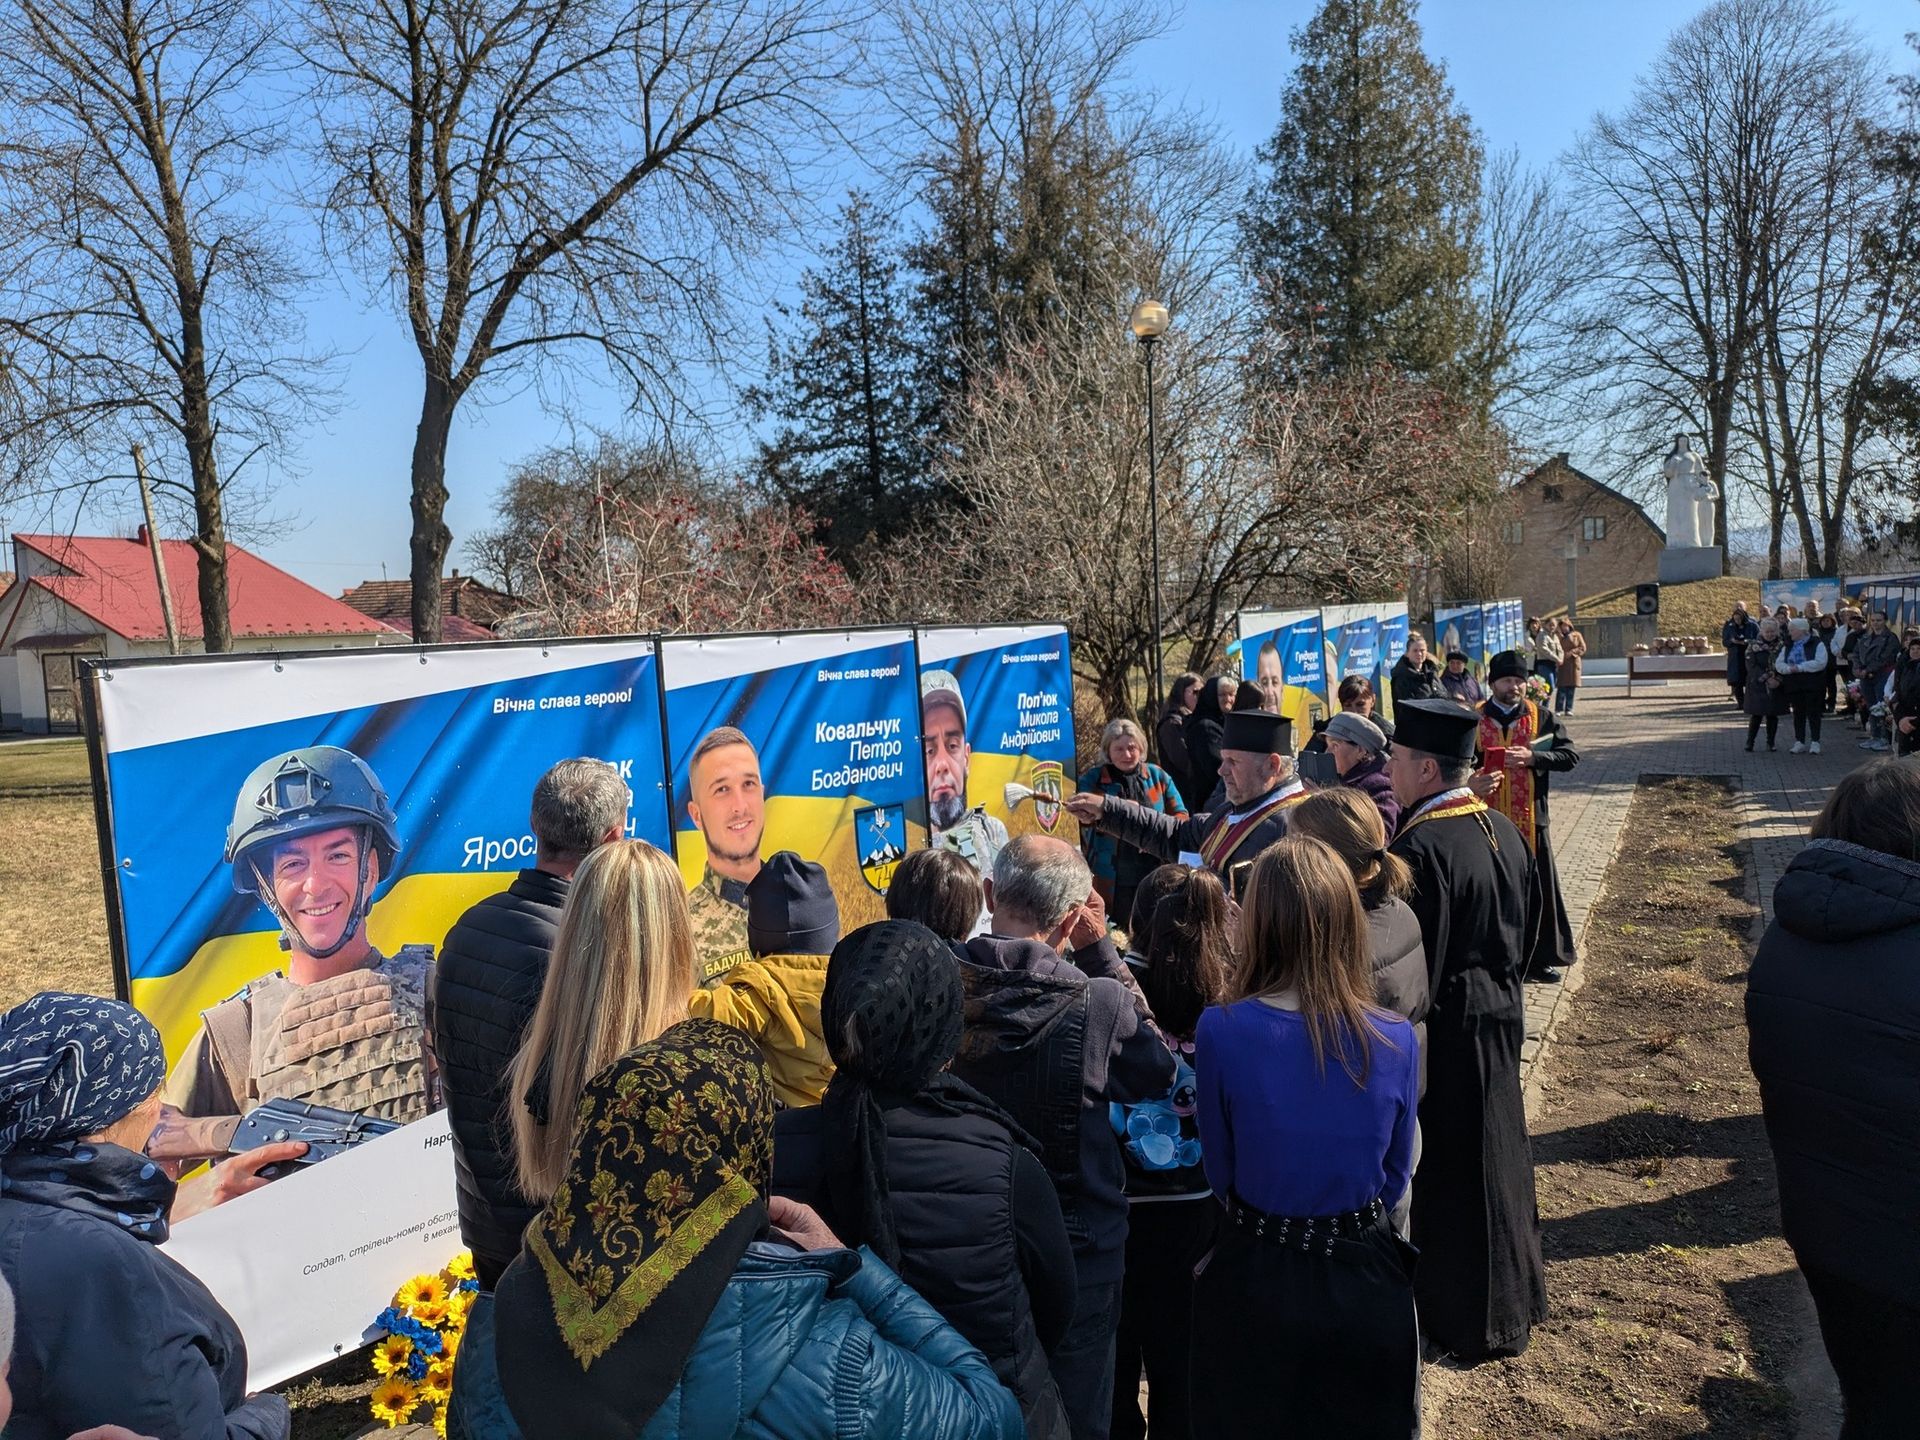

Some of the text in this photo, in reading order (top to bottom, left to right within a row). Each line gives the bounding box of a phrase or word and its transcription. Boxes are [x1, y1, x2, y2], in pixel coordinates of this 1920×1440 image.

[1002, 650, 1060, 665] Вічна слава герою!
[818, 664, 900, 682] Вічна слава герою!
[493, 688, 632, 714] Вічна слава герою!
[1019, 709, 1059, 729] Микола
[815, 718, 901, 744] Ковальчук
[1000, 728, 1061, 750] Андрійович
[849, 740, 902, 762] Петро
[811, 761, 903, 791] Богданович
[704, 950, 752, 977] БАДУЛА
[424, 1132, 453, 1149] Наро
[303, 1209, 458, 1276] Солдат, стрілець-номер обслуг
[423, 1223, 460, 1243] 8 механ
